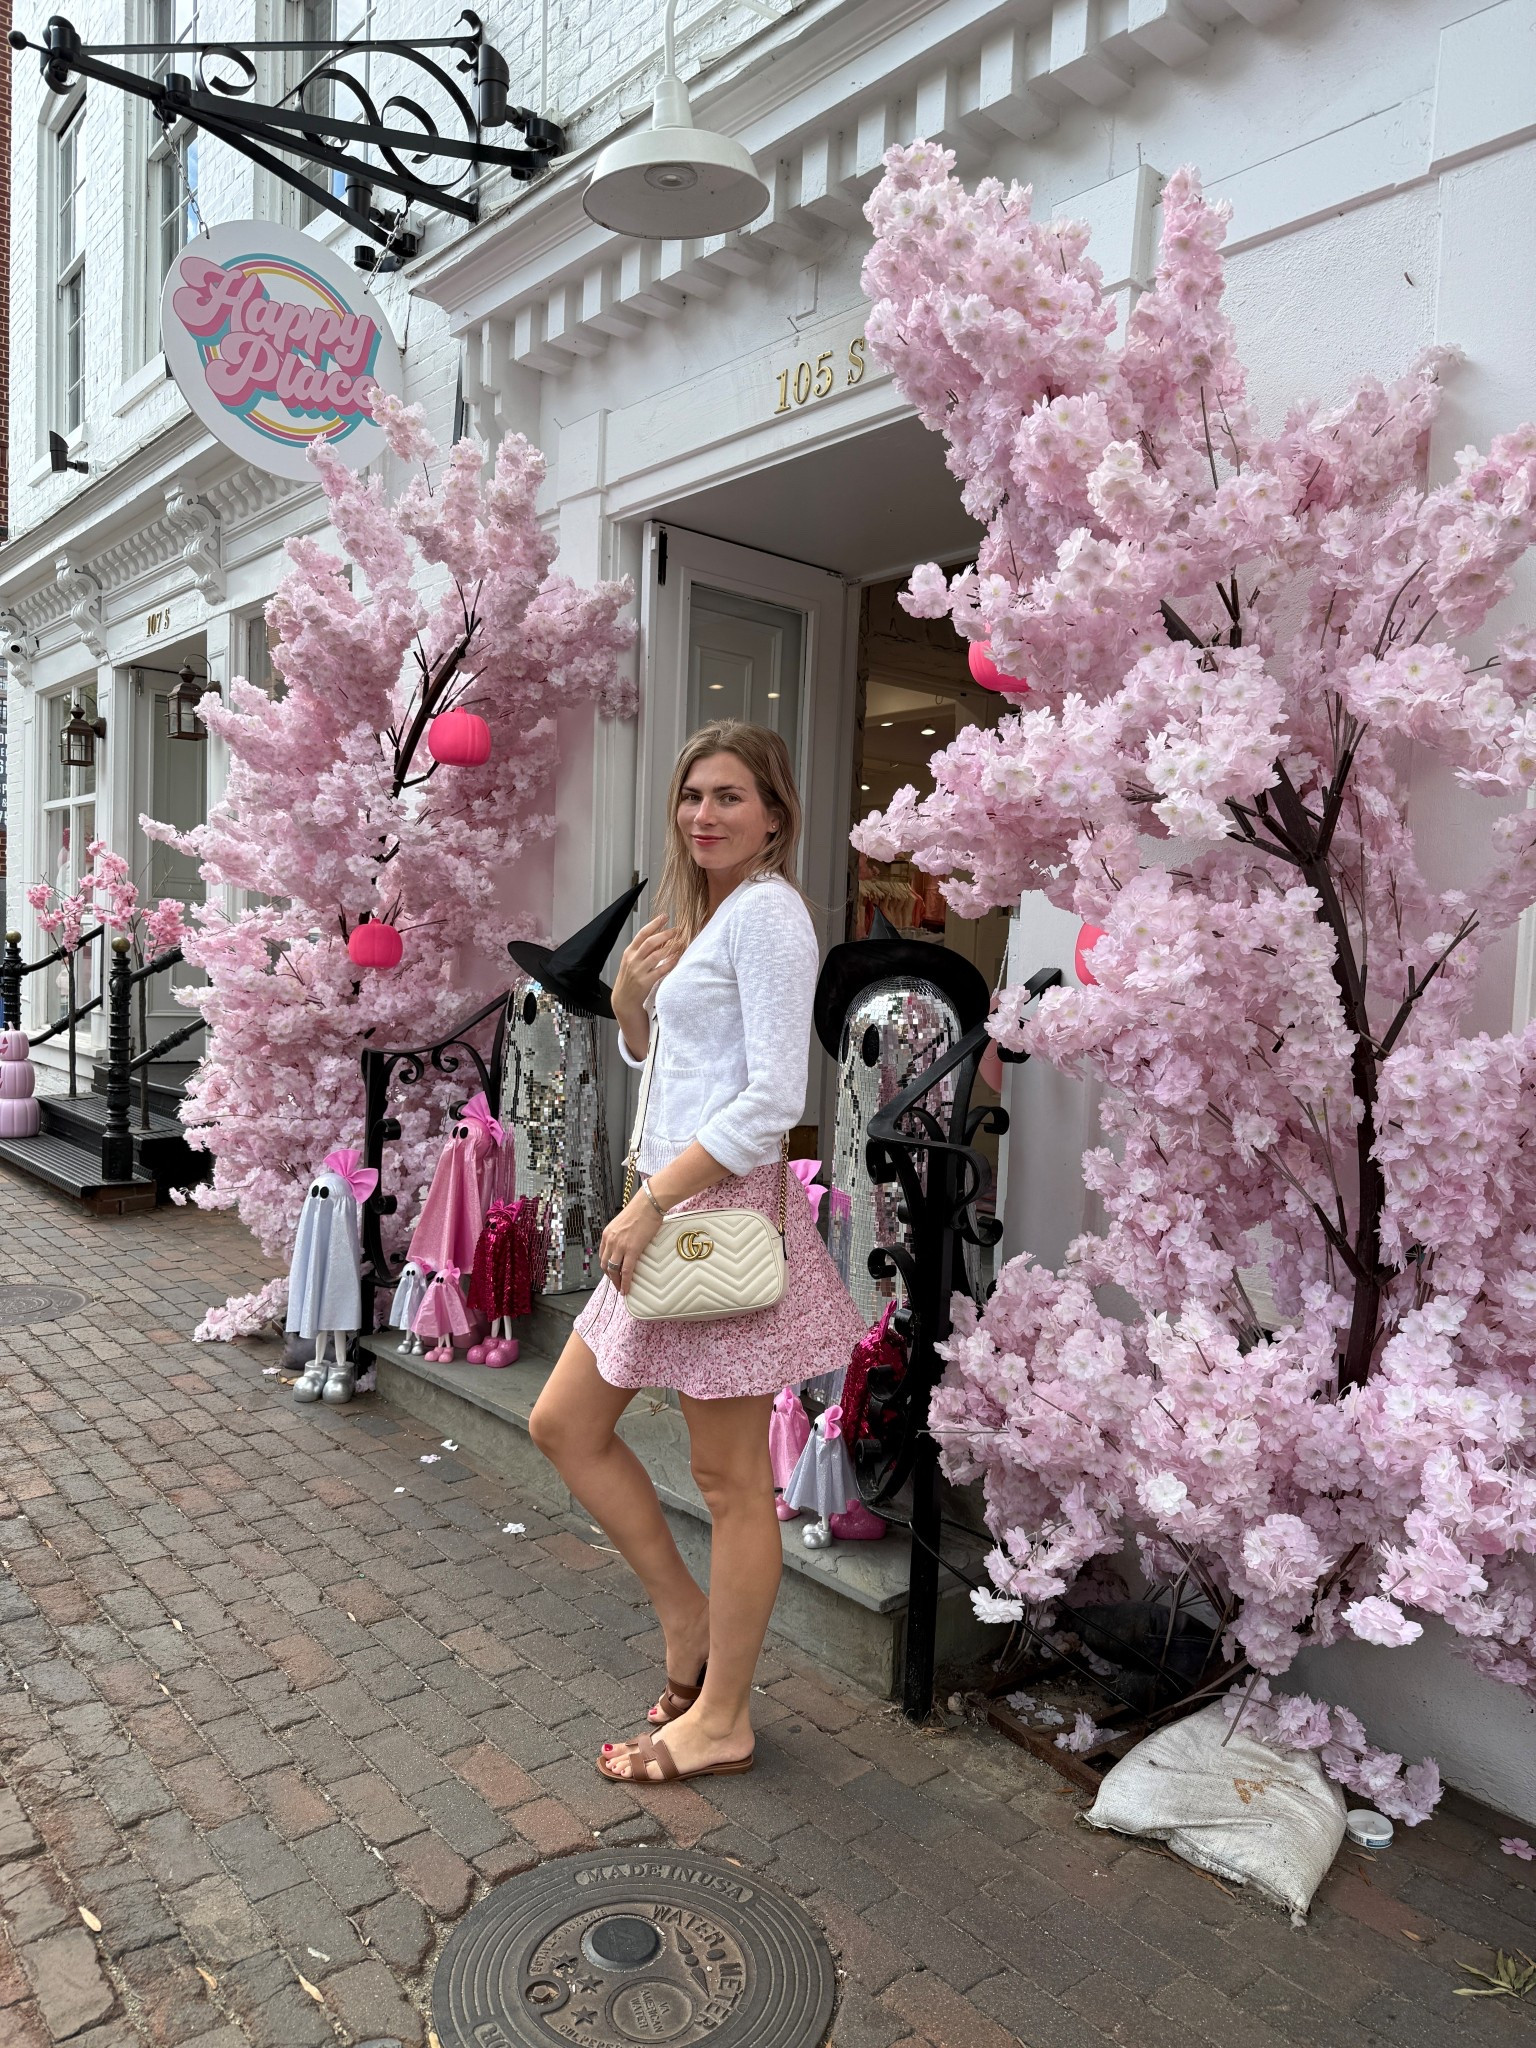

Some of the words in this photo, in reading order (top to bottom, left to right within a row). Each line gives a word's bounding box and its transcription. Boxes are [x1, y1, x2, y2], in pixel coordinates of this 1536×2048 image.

[173, 256, 378, 372] Happy
[205, 331, 380, 416] Place
[774, 350, 833, 414] 105
[847, 336, 865, 385] S
[146, 611, 162, 638] 107
[164, 607, 171, 630] S
[586, 1863, 661, 1884] MADE
[667, 1864, 699, 1883] IN
[700, 1876, 744, 1900] USA
[652, 1904, 726, 1949] WATER
[693, 1962, 744, 2031] METER
[630, 1997, 649, 2029] WATER
